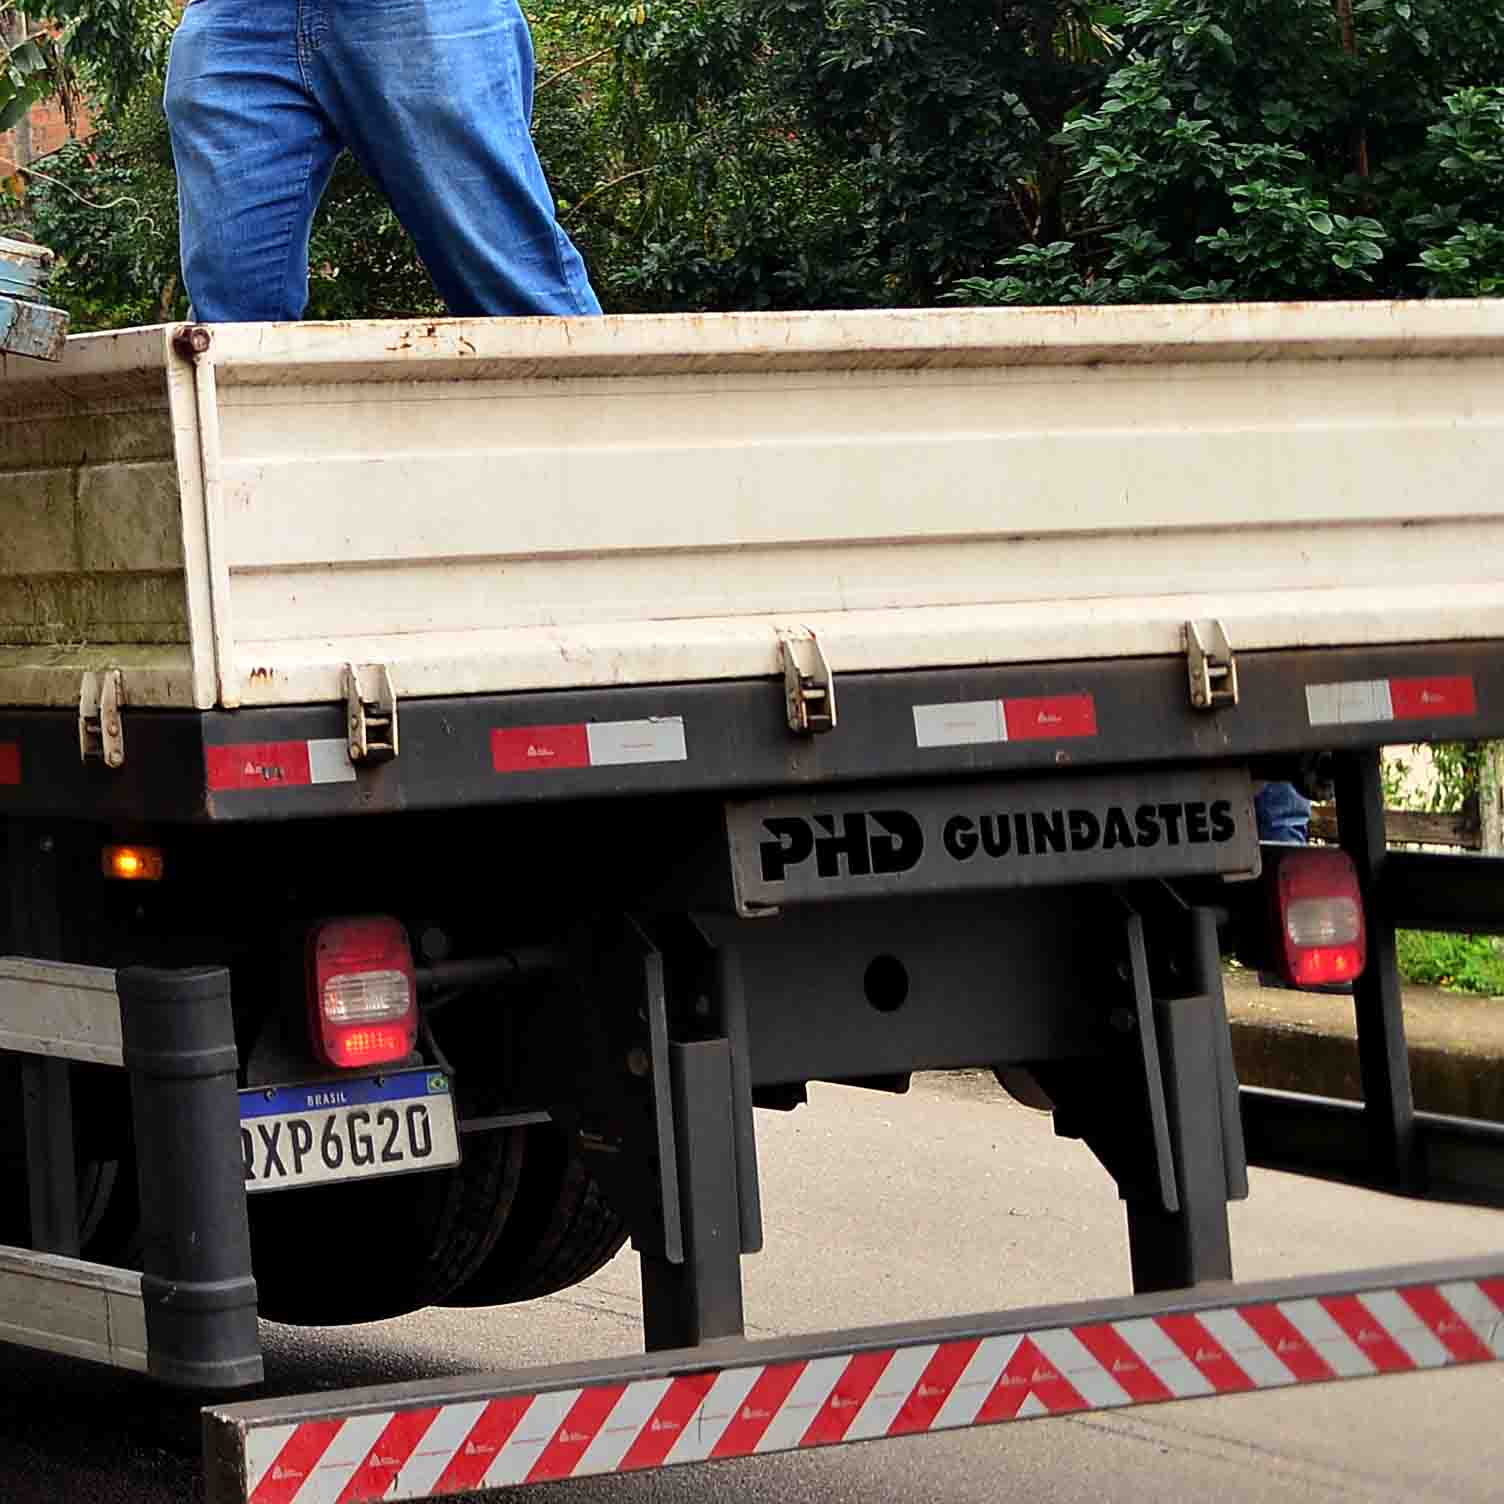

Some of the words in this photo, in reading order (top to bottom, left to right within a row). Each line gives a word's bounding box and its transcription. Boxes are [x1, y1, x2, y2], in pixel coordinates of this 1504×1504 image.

[759, 809, 925, 882] PHD
[942, 799, 1236, 862] GUINDASTES
[306, 1091, 348, 1107] BRASIL
